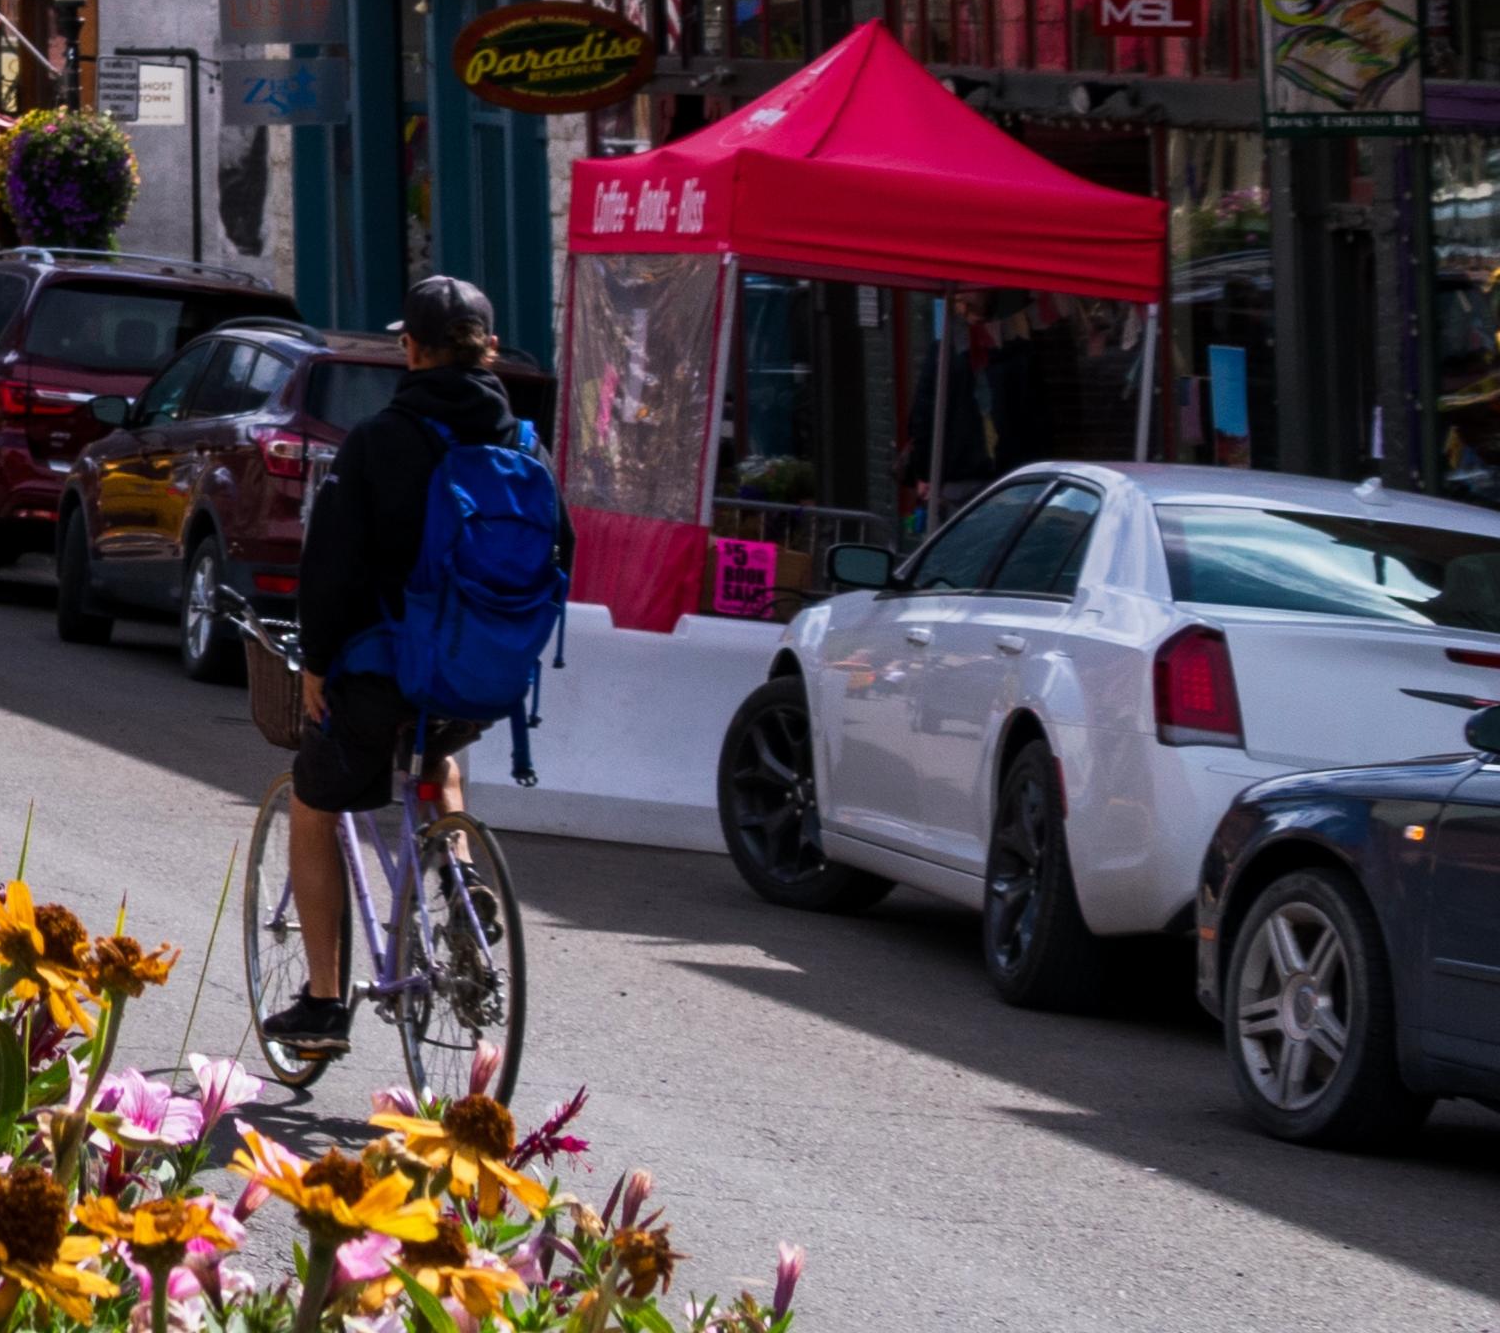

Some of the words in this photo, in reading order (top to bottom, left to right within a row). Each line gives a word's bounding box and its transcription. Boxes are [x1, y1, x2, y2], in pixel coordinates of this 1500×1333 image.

[465, 30, 645, 85] Paradise
[140, 82, 173, 91] HOST
[1268, 115, 1312, 128] BOOKS
[1320, 115, 1390, 128] ESPRESSO
[1392, 114, 1421, 127] BAR
[593, 179, 629, 234] Coffee
[723, 565, 767, 585] BOOK
